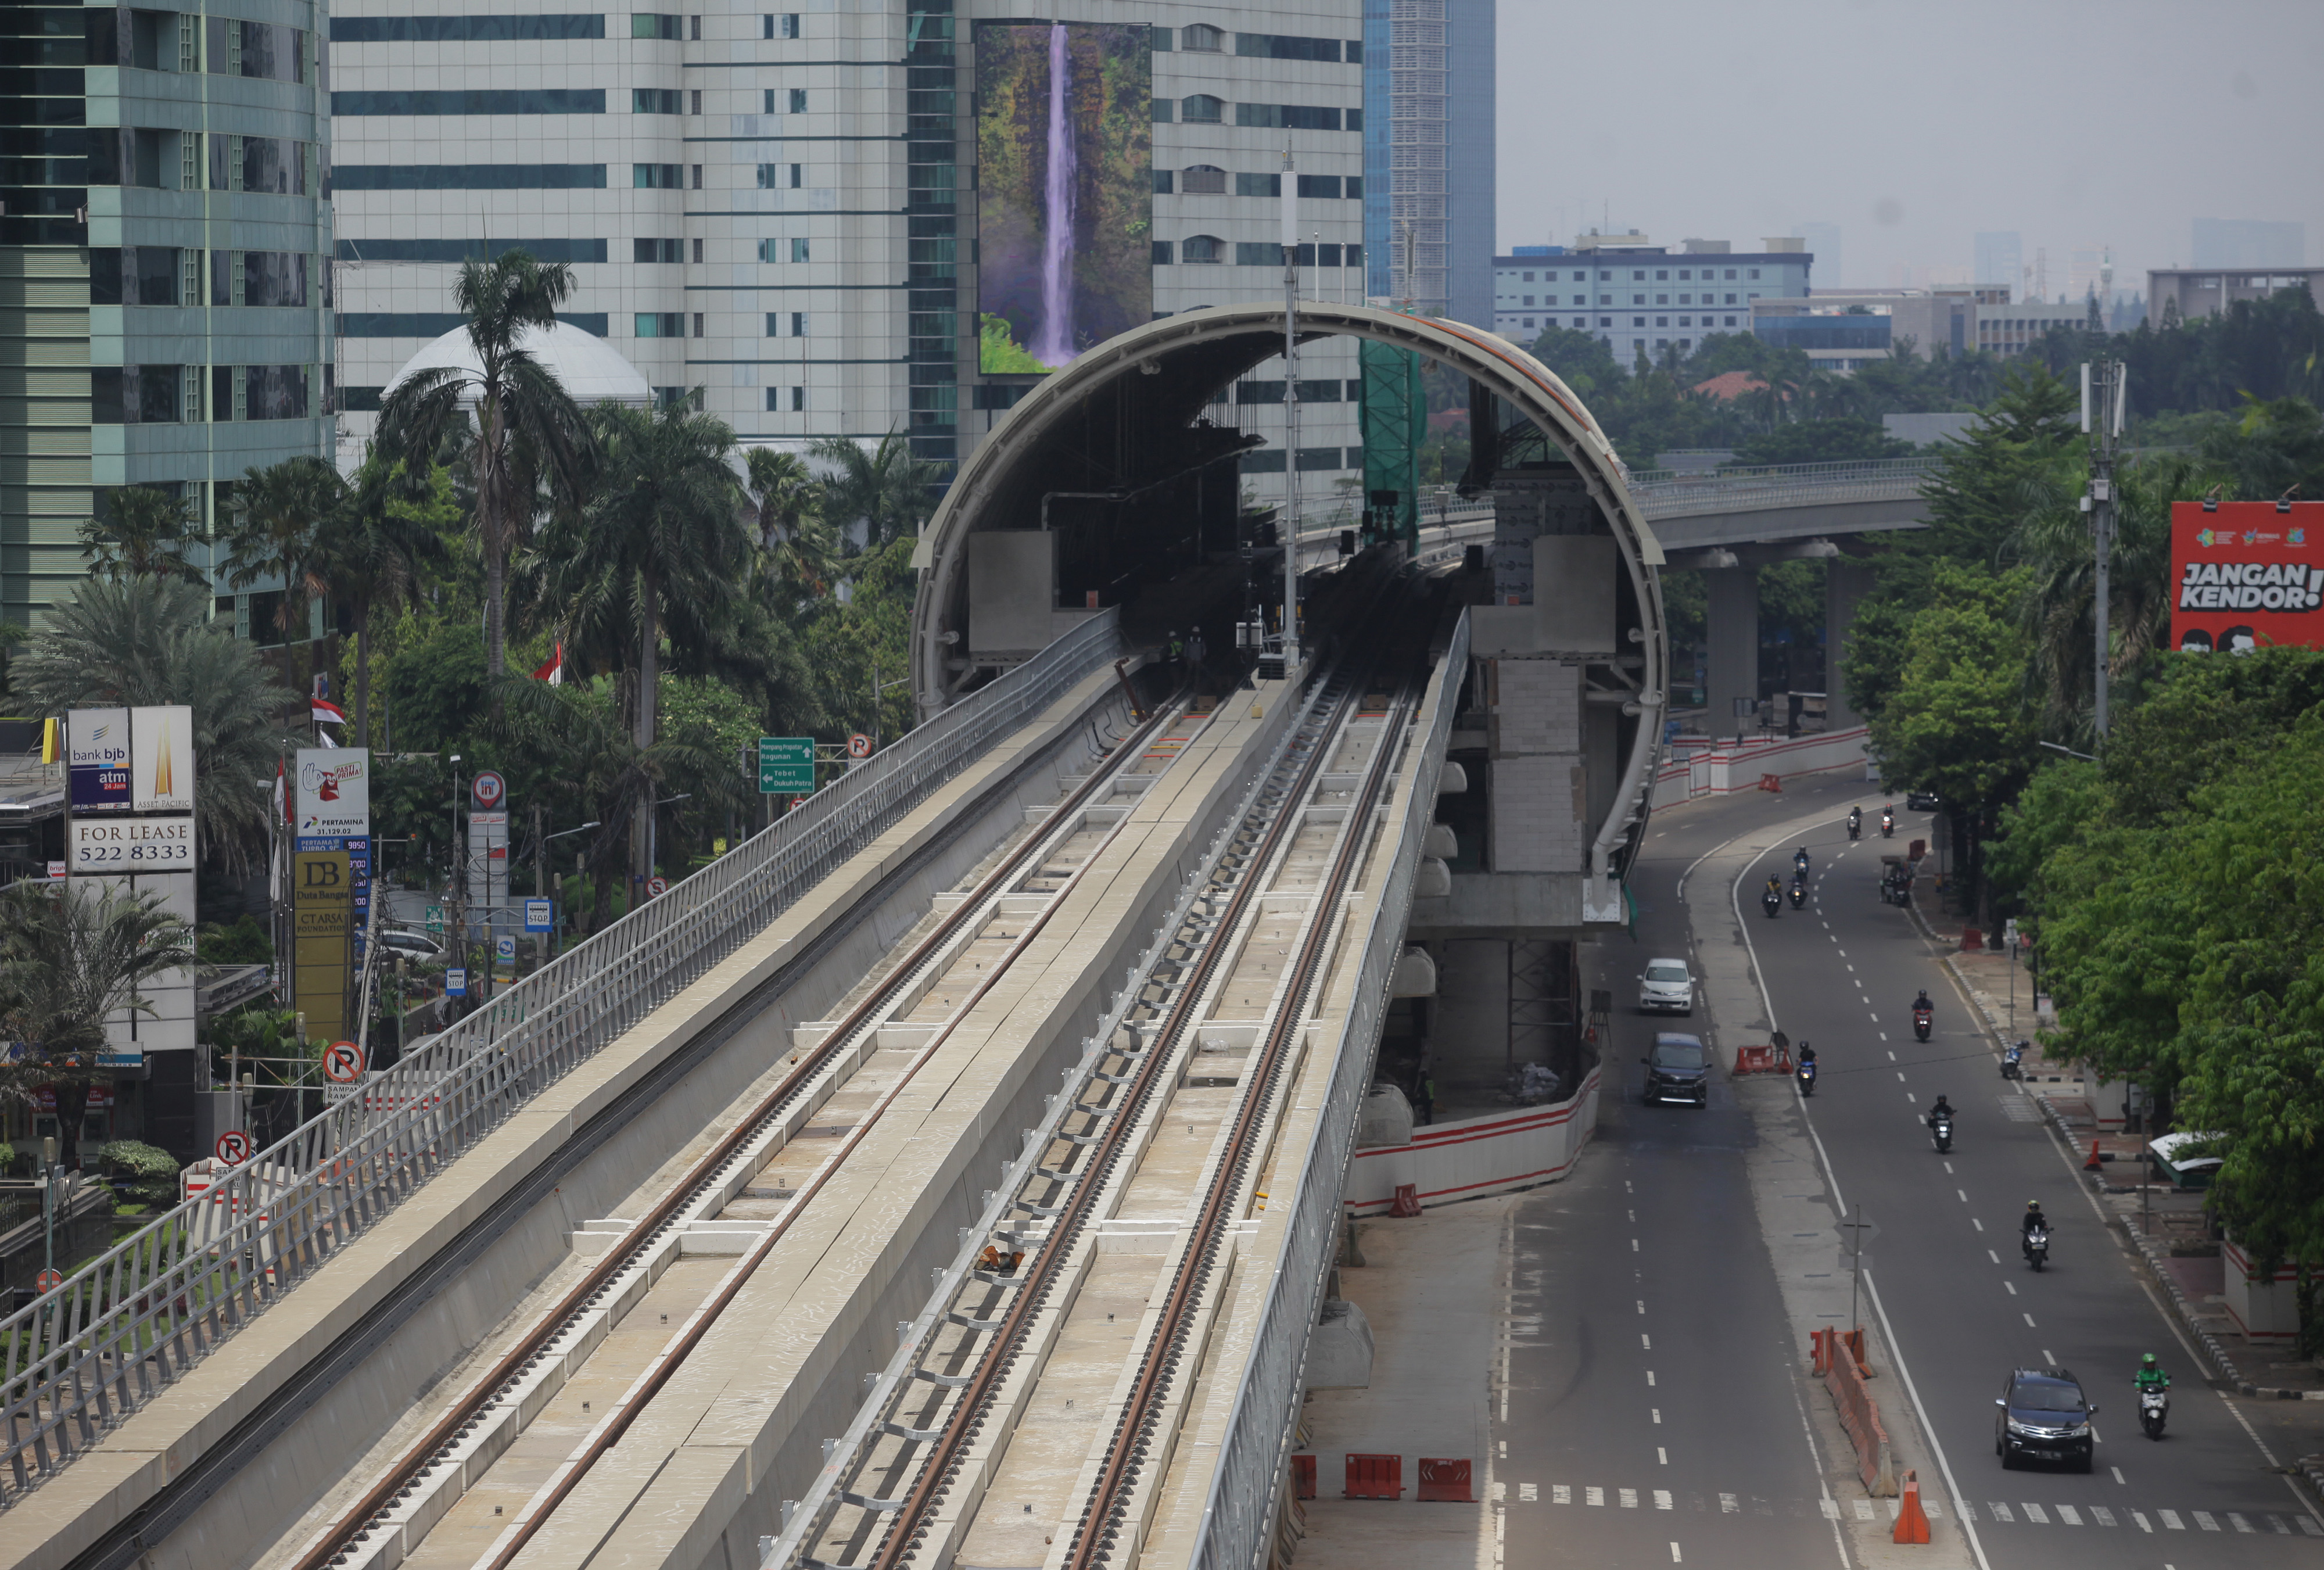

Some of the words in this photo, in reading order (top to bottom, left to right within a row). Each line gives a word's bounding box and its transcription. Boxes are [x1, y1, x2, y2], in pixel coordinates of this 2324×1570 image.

[2182, 563, 2308, 586] JANGAN
[73, 749, 101, 761] bank
[105, 748, 125, 761] bjb
[336, 764, 354, 774] PASTI
[338, 769, 361, 780] PRIMA!
[99, 771, 126, 783] atm
[80, 827, 123, 841] FOR
[129, 825, 187, 840] LEASE
[349, 841, 365, 849] 9850
[80, 847, 122, 861] 522
[131, 845, 188, 859] 8333
[304, 861, 340, 886] DB
[297, 891, 317, 900] Duta
[318, 891, 349, 901] Bangsa
[301, 914, 317, 924] CT
[317, 913, 343, 923] ARSA
